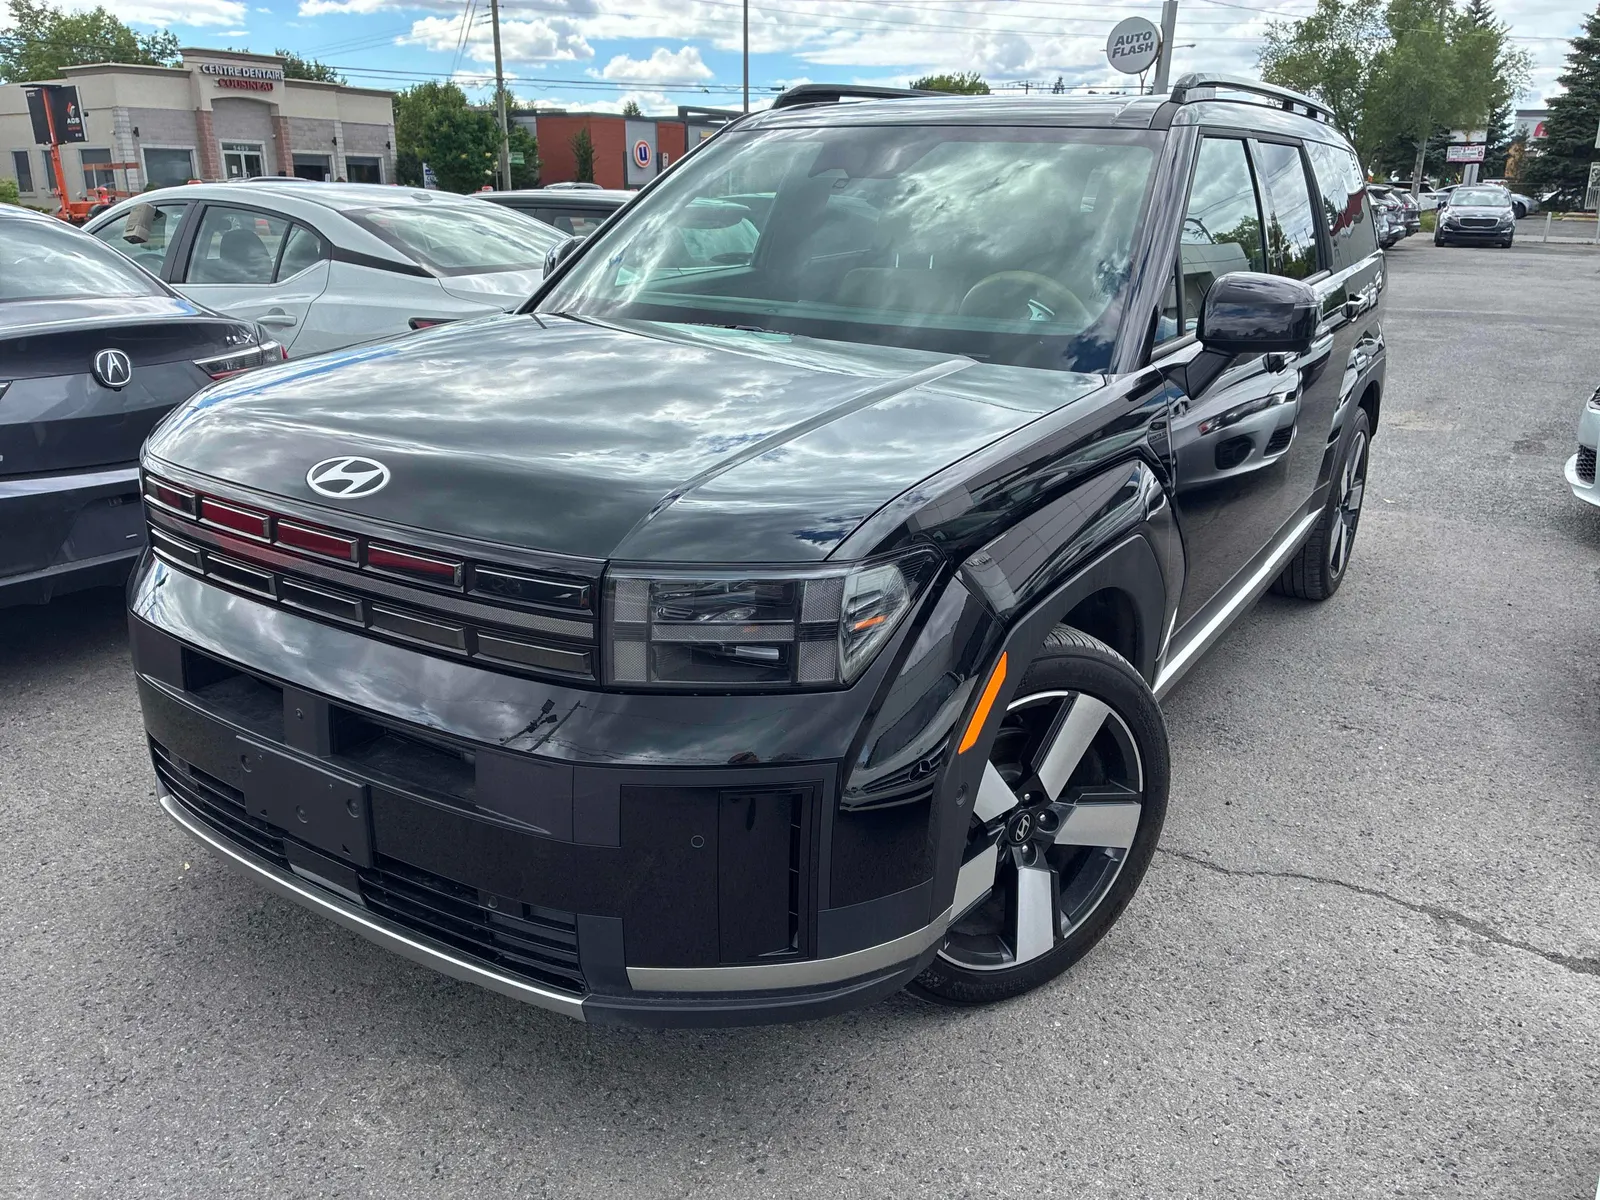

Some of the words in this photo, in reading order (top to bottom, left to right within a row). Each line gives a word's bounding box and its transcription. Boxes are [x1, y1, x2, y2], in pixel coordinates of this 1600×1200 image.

[1114, 31, 1152, 47] AUTO
[1112, 41, 1154, 59] FLASH
[202, 64, 242, 77] CENTRE
[242, 68, 285, 80] DENTAIRE
[218, 79, 274, 91] COUSINEAU
